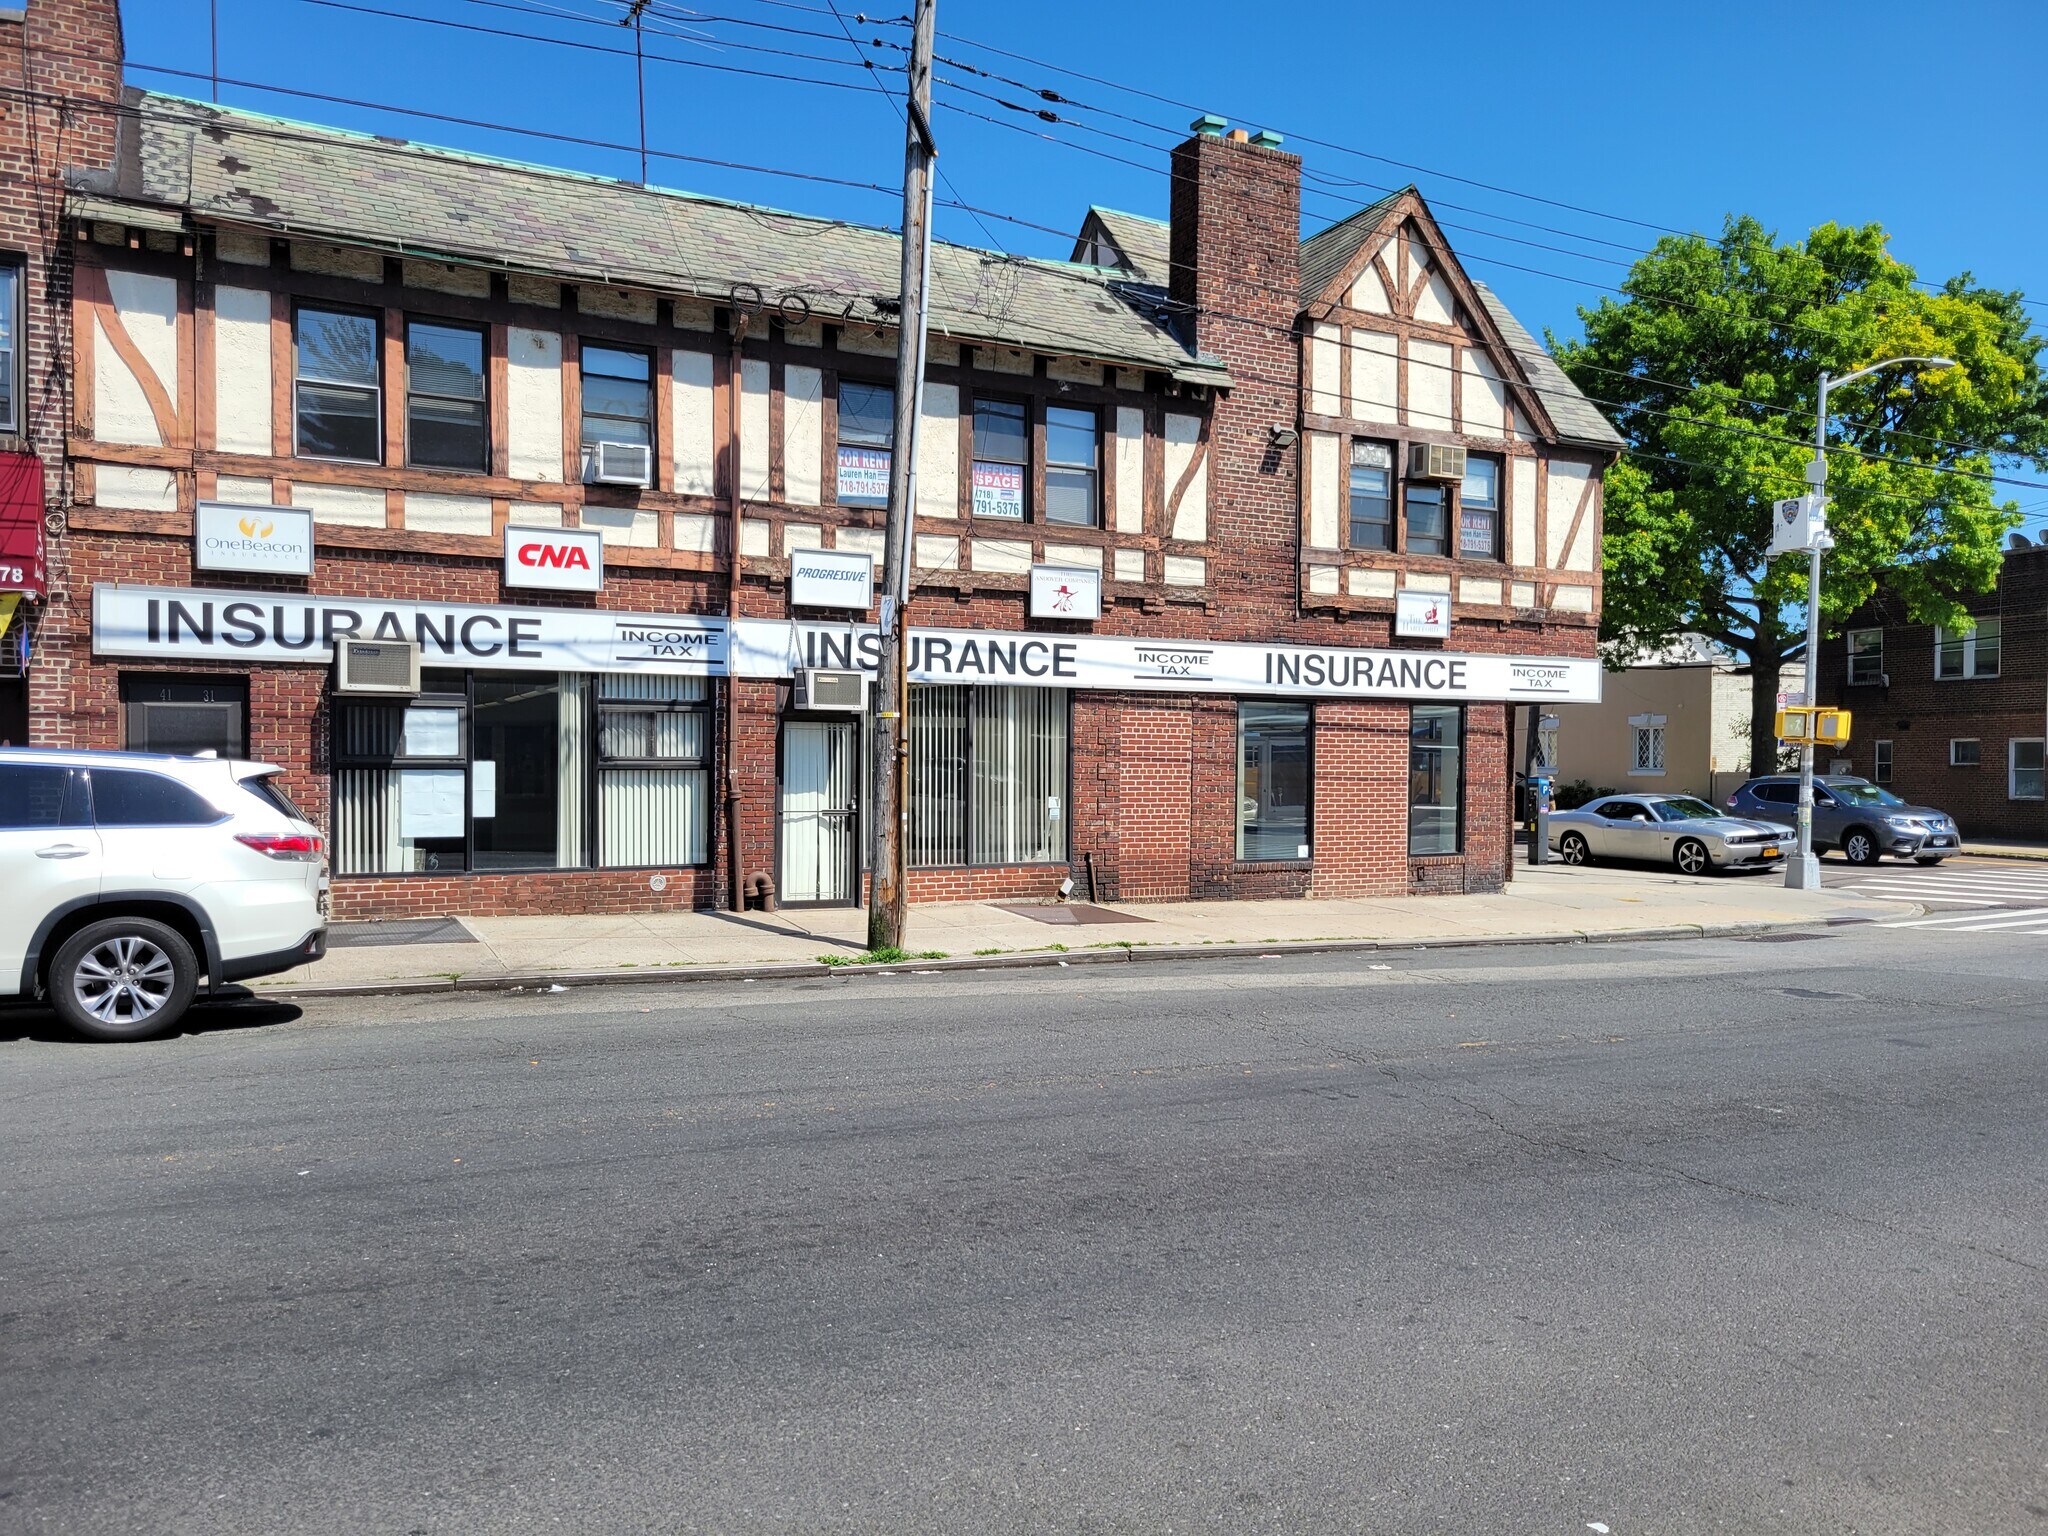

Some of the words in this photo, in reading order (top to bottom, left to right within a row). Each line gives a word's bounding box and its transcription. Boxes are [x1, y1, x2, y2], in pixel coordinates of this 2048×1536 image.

[839, 450, 859, 467] FOR
[862, 451, 890, 469] RENT
[840, 468, 862, 479] Lauren
[863, 469, 877, 479] Han
[976, 462, 1020, 477] OFFICE
[976, 474, 1020, 489] SPACE
[976, 500, 1020, 516] 791-5376
[1461, 514, 1471, 528] OR
[205, 537, 303, 554] OneBeacon
[517, 543, 591, 571] CNA
[796, 567, 867, 582] PROGRESSIVE
[147, 598, 544, 658] INSURANCE
[622, 630, 719, 646] INCOME
[648, 644, 693, 657] TAX
[1138, 653, 1210, 665] INCOME
[1157, 664, 1191, 676] TAX
[1265, 652, 1467, 690] INSURANCE
[1513, 668, 1567, 679] INCOME
[1527, 679, 1553, 688] TAX
[160, 688, 172, 701] 41
[203, 689, 216, 703] 31
